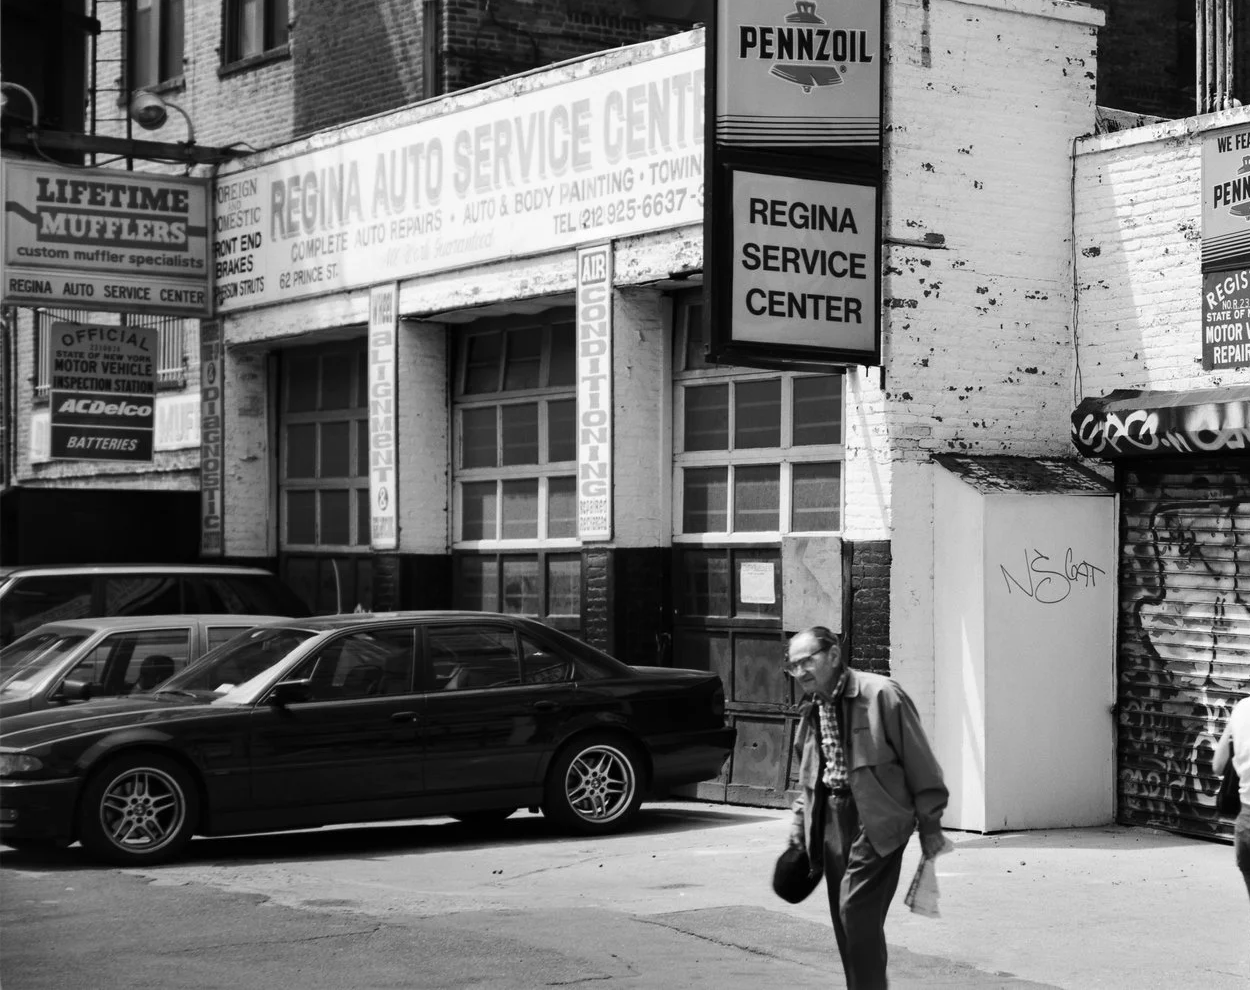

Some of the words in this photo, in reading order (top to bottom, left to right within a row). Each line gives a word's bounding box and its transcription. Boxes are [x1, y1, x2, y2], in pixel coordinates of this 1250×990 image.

[739, 25, 874, 63] PENNZOIL
[1218, 136, 1232, 153] WE
[270, 160, 364, 242] REGINA
[372, 137, 443, 216] AUTO
[453, 98, 592, 199] SERVICE
[36, 177, 189, 213] LIFETIME
[215, 178, 258, 204] OREIGN
[291, 232, 348, 262] COMPLETE
[354, 223, 385, 248] AUTO
[390, 209, 442, 240] REPAIRS
[463, 198, 495, 225] AUTO
[514, 185, 555, 214] BODY
[559, 167, 634, 205] PAINTING
[750, 197, 858, 234] REGINA
[40, 211, 187, 245] MUFFLERS
[241, 232, 262, 252] END
[17, 246, 69, 259] custom
[74, 250, 126, 263] muffler
[128, 254, 204, 269] specialists
[582, 253, 606, 281] AIR
[741, 242, 867, 279] SERVICE
[240, 276, 264, 298] STRUTS
[279, 272, 291, 290] 62
[293, 266, 323, 287] PRINCE
[9, 278, 52, 294] REGINA
[62, 282, 95, 298] AUTO
[104, 285, 151, 301] SERVICE
[160, 288, 205, 304] CENTER
[745, 288, 862, 324] CENTER
[1206, 310, 1231, 322] STATE
[1234, 308, 1245, 319] OF
[61, 328, 149, 352] OFFICIAL
[1206, 323, 1242, 344] MOTOR
[54, 359, 97, 373] MOTOR
[102, 362, 153, 376] VEHICLE
[128, 354, 151, 362] YORK
[53, 376, 111, 390] INSPECTION
[114, 379, 154, 393] STATION
[580, 285, 608, 498] CONDITIONING
[58, 399, 152, 417] ACDelco
[67, 436, 138, 451] BATTERIES
